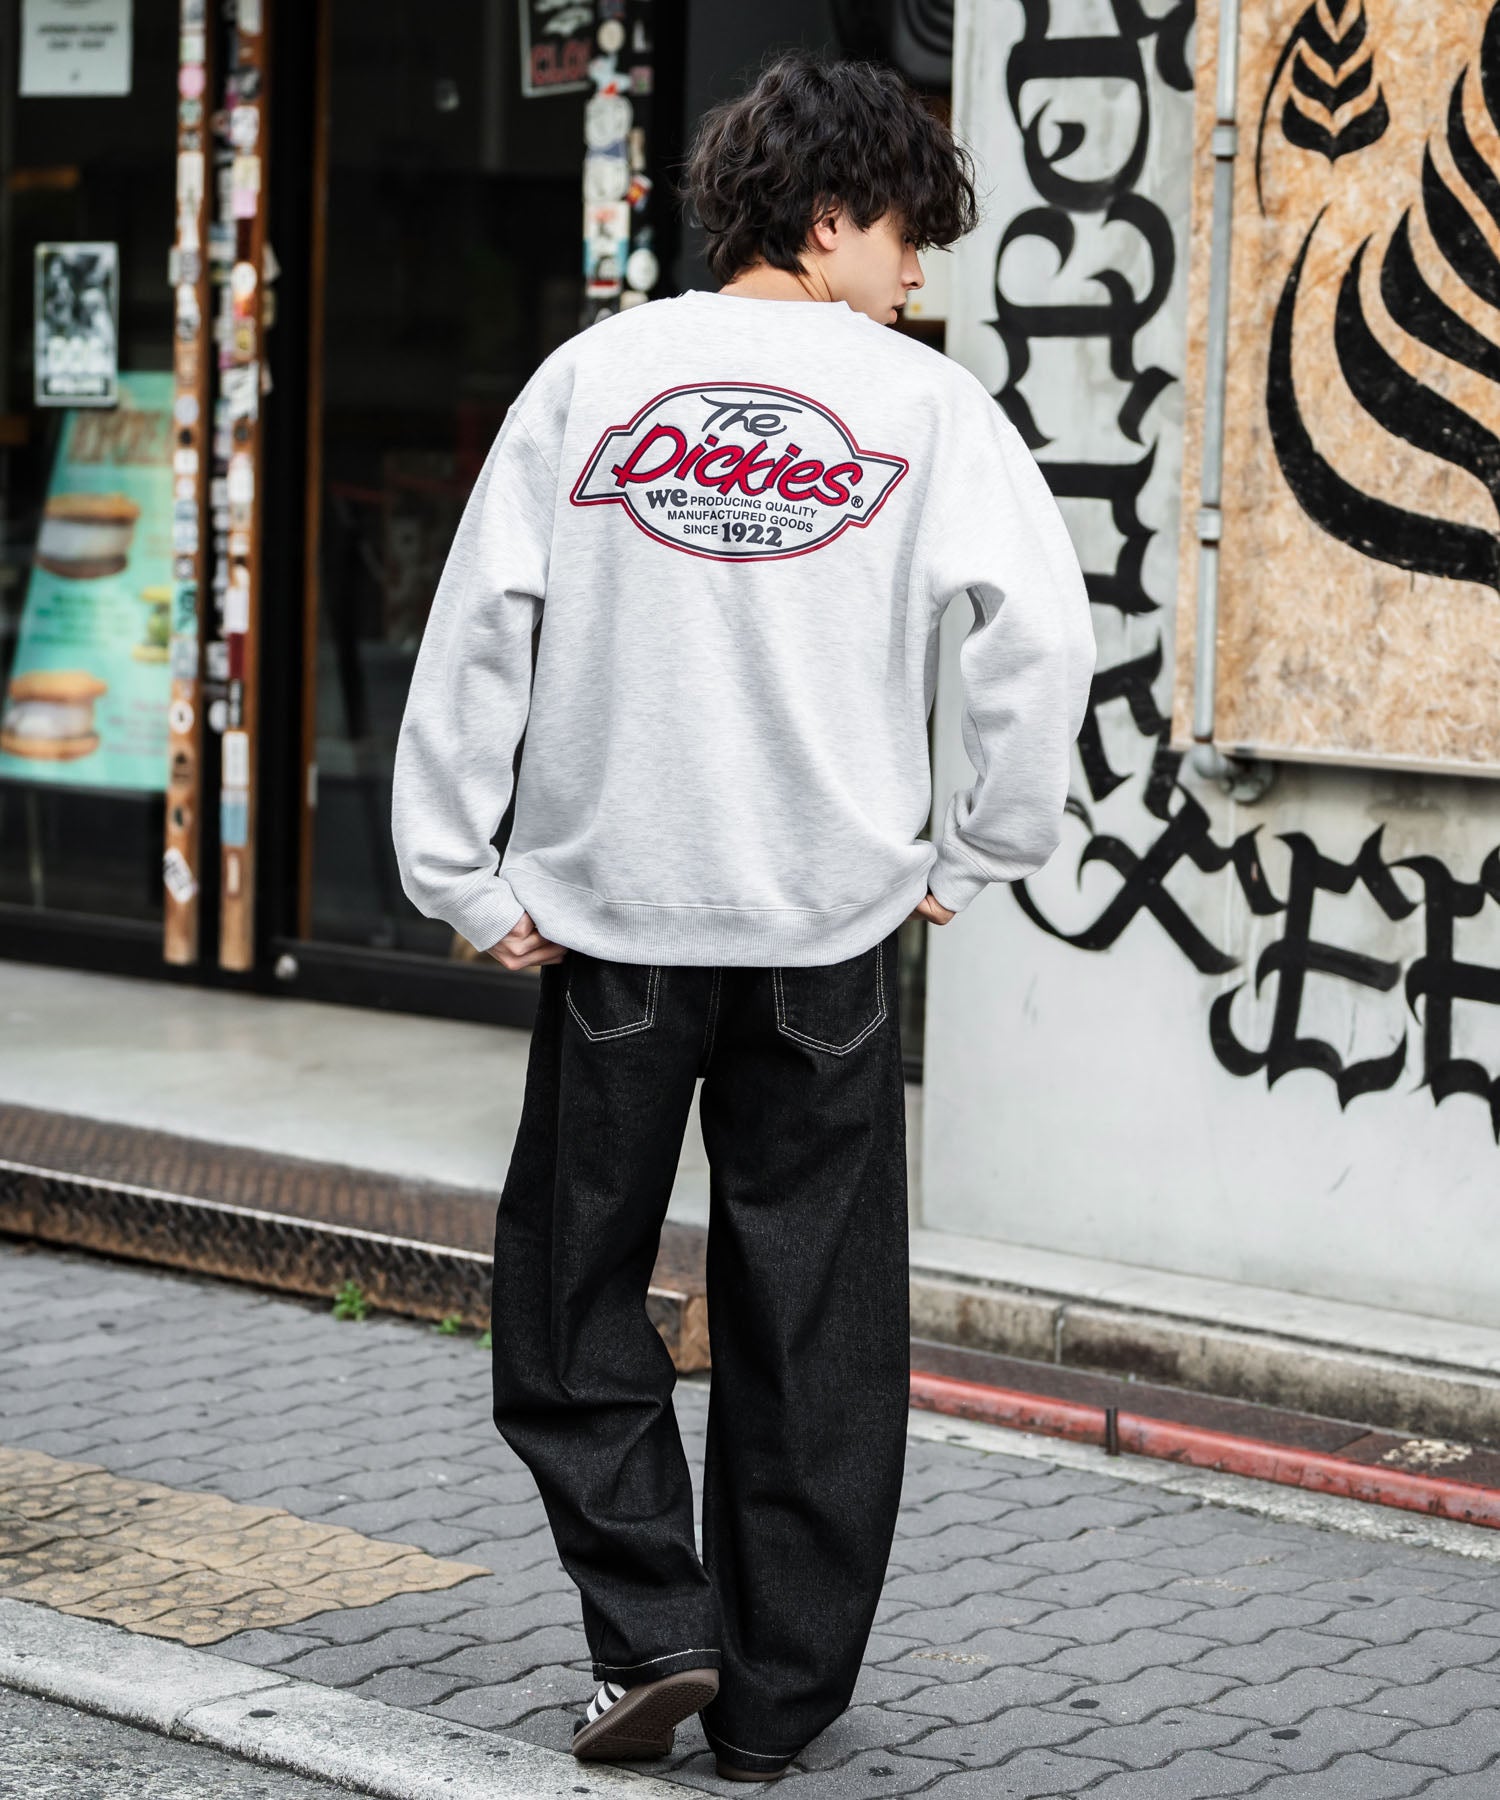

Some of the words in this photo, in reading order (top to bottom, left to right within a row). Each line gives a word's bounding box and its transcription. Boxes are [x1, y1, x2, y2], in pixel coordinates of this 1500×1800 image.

[700, 394, 803, 437] The
[611, 423, 863, 507] Dickies
[646, 489, 688, 510] we
[690, 496, 762, 509] PRODUCING
[765, 500, 818, 519] QUALITY
[667, 510, 767, 523] MANUFACTURED
[769, 515, 814, 533] GOODS
[683, 524, 718, 536] SINCE
[721, 522, 783, 548] 1922
